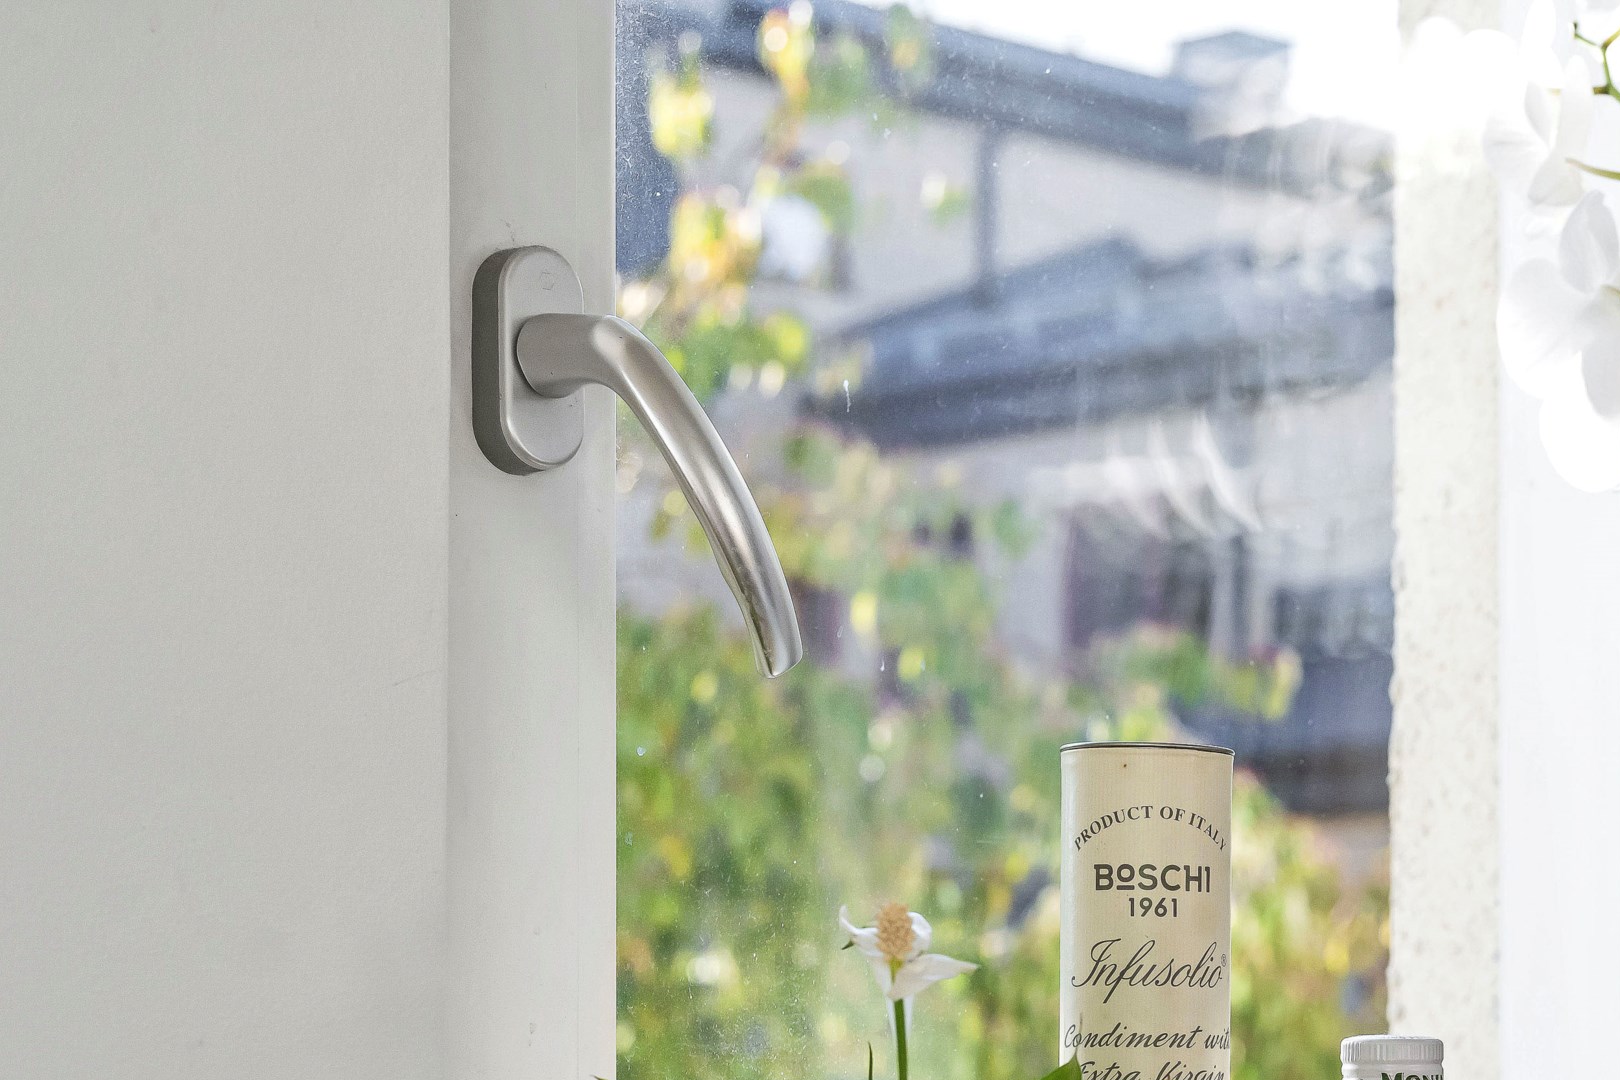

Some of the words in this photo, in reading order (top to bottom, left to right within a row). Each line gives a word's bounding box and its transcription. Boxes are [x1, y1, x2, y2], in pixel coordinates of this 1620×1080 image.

[1074, 805, 1153, 851] PRODUCT
[1159, 805, 1186, 822] OF
[1188, 812, 1227, 851] ITALY
[1128, 897, 1178, 918] 1961
[1064, 1022, 1203, 1049] Condiment
